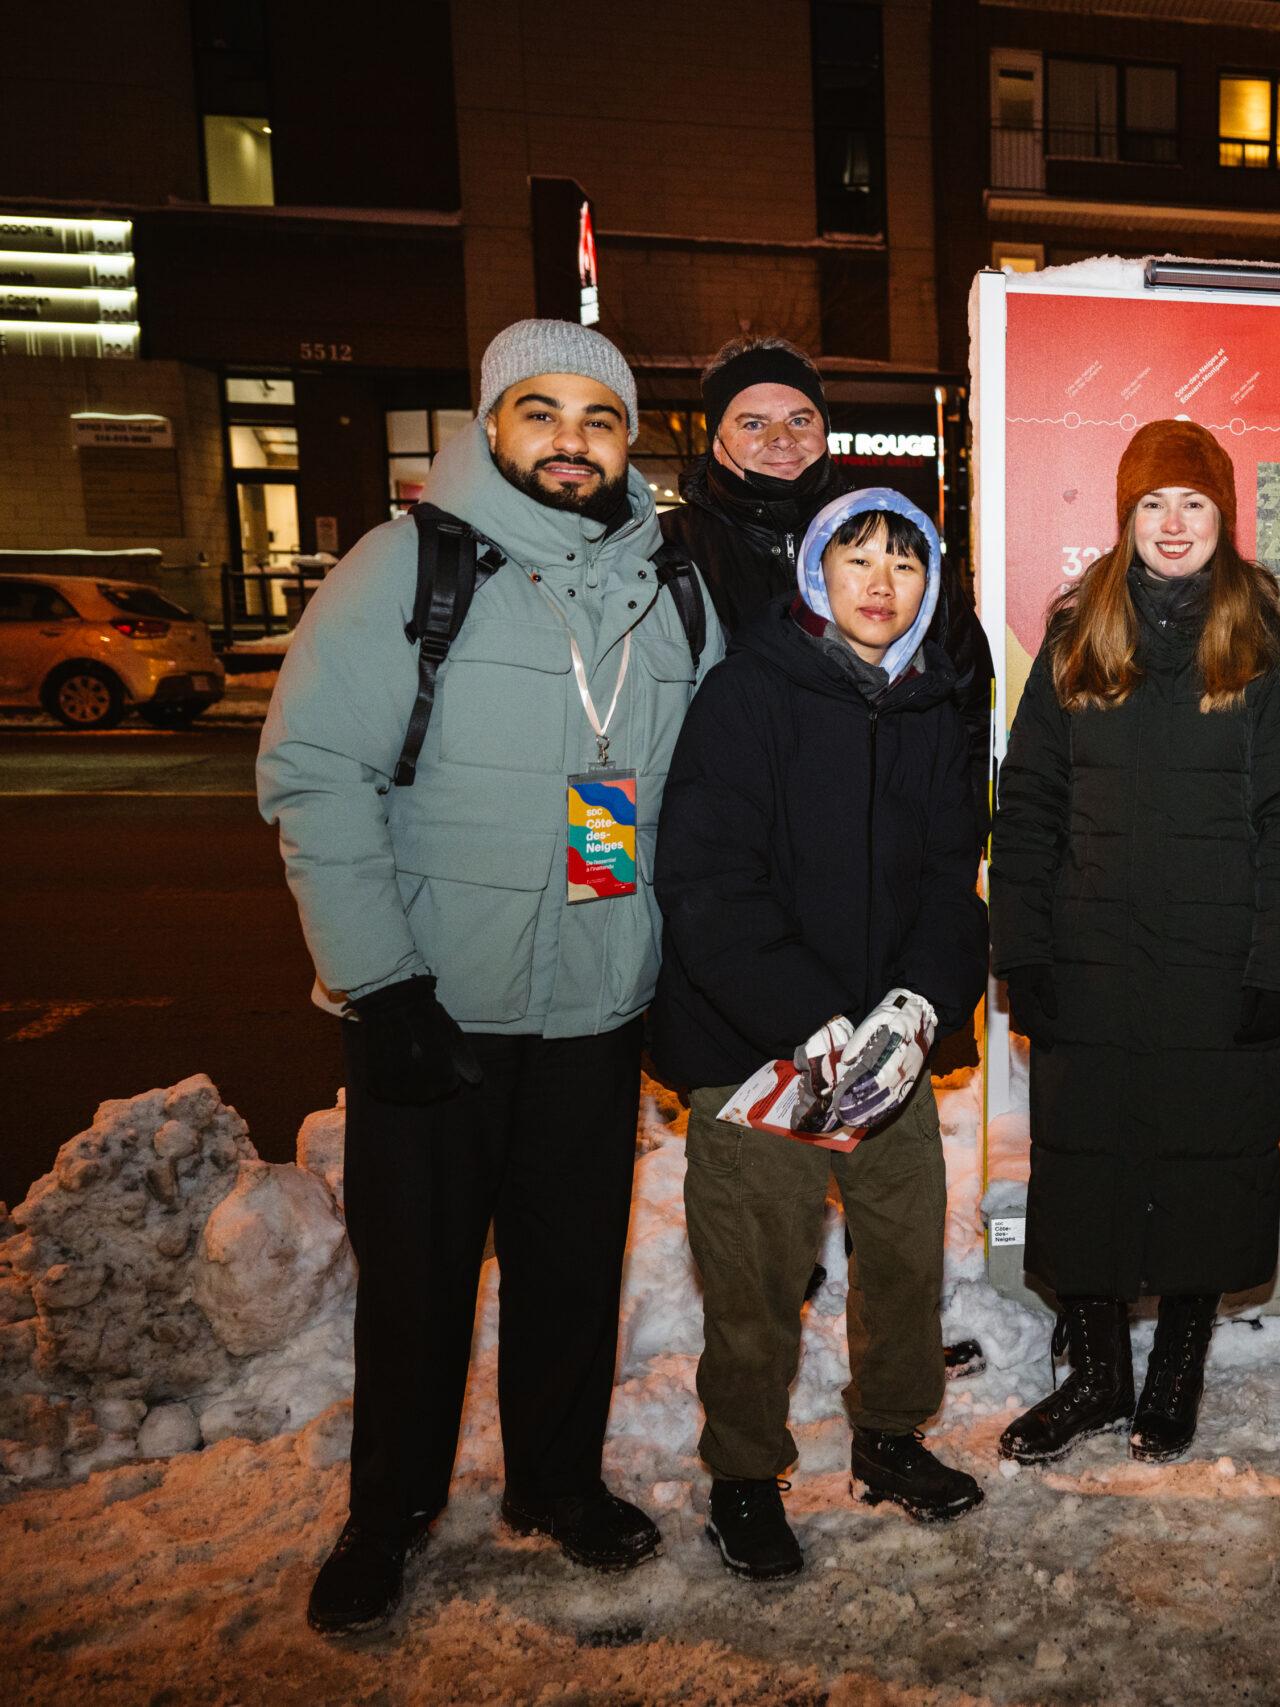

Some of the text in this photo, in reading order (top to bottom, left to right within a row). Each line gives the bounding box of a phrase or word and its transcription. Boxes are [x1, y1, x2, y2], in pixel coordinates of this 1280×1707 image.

[301, 343, 352, 361] 5512
[1174, 355, 1219, 398] Côte-des-Neiges
[855, 434, 936, 456] ROUGE
[586, 819, 618, 830] Côte-
[586, 831, 610, 842] des-
[586, 840, 624, 854] Neiges
